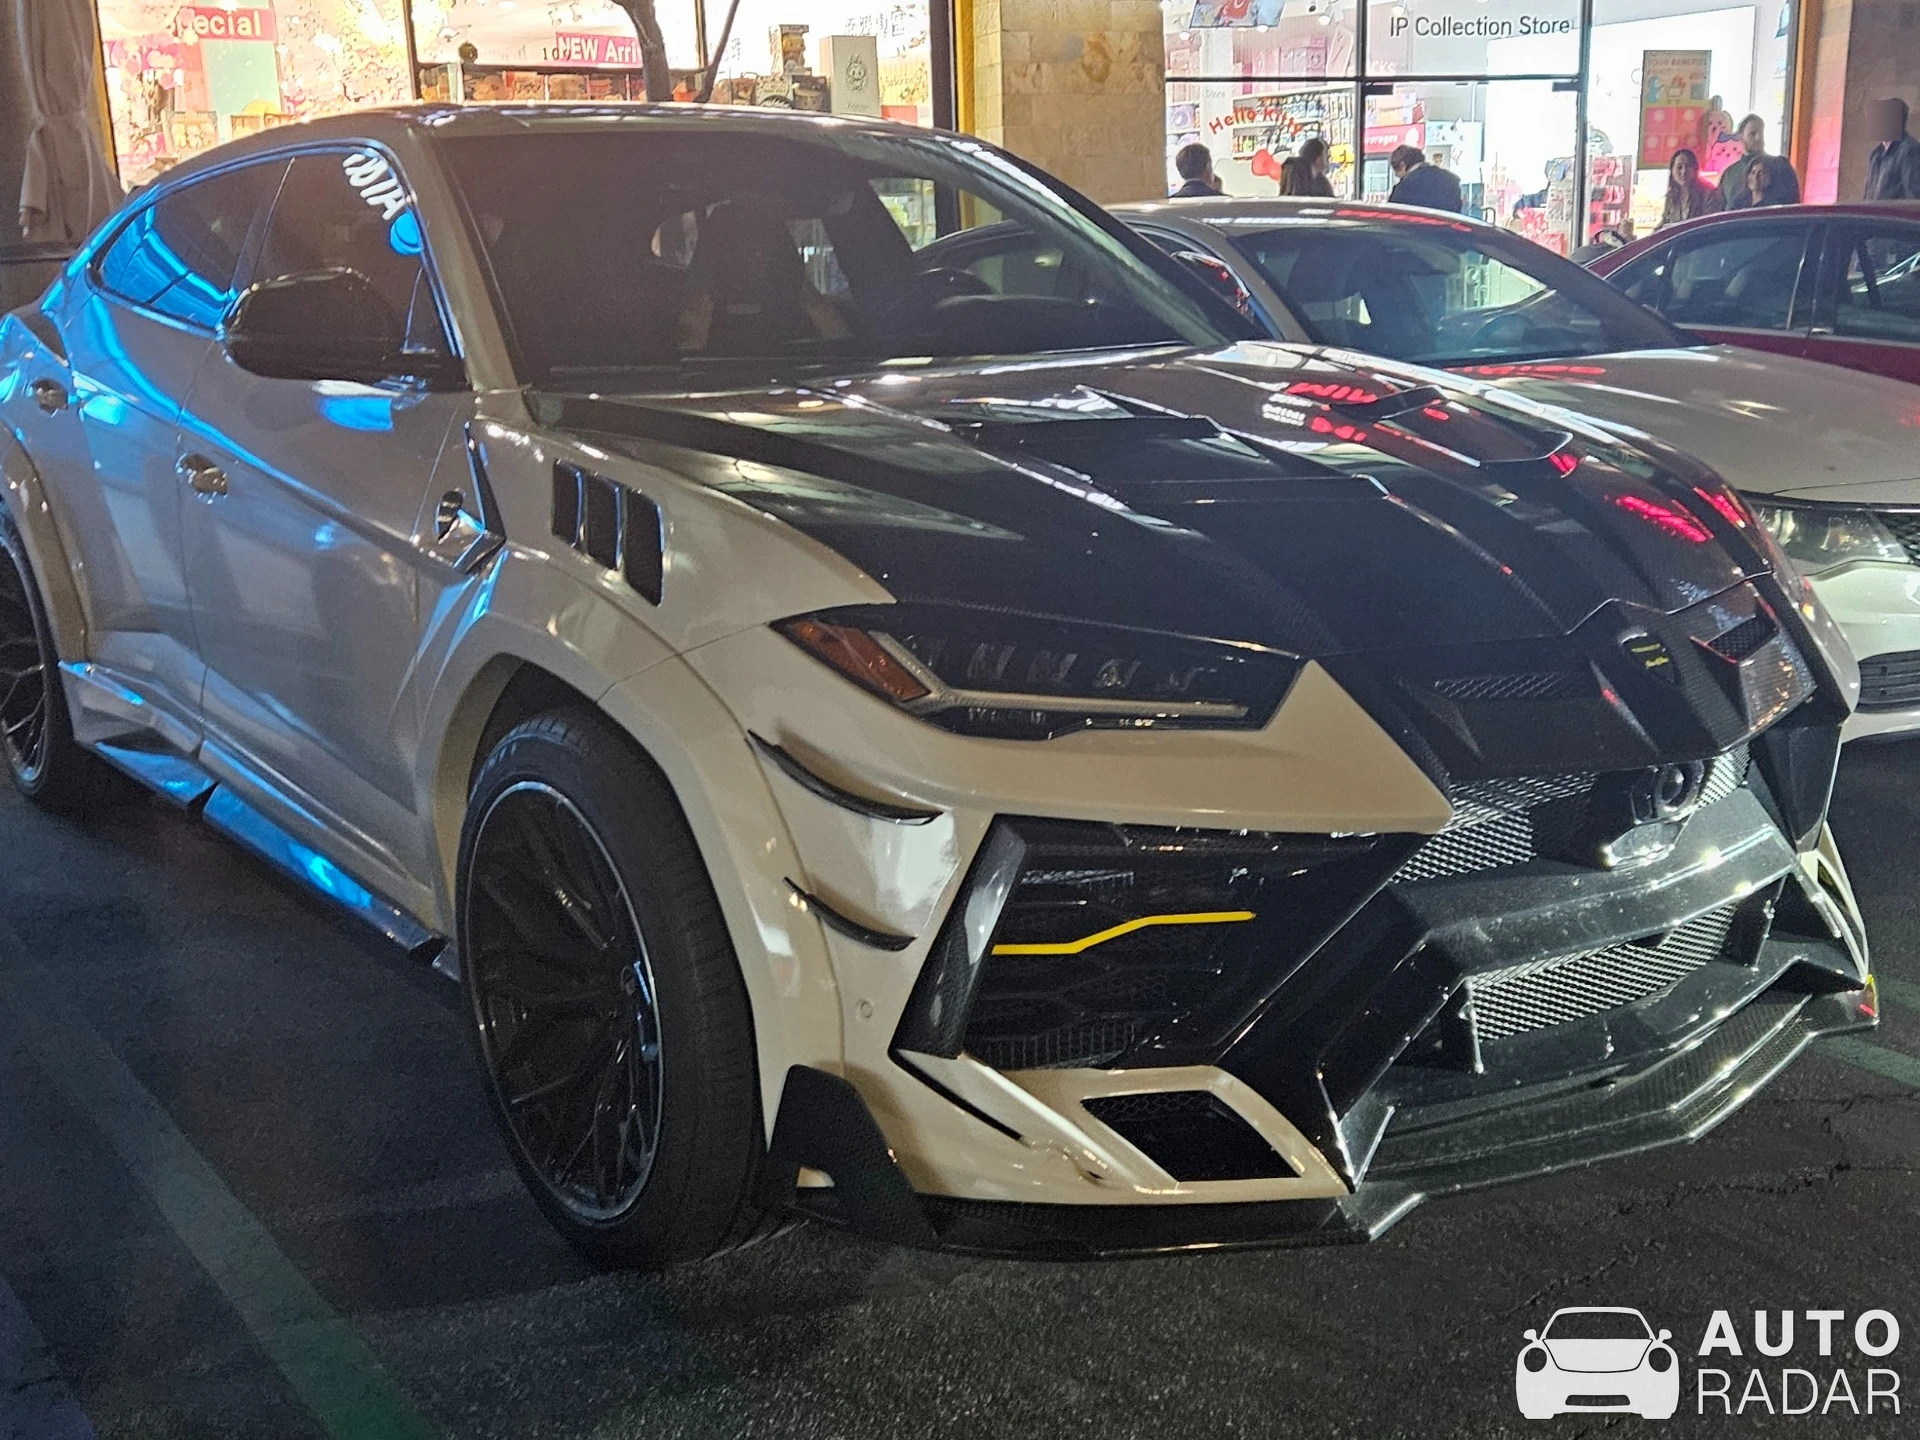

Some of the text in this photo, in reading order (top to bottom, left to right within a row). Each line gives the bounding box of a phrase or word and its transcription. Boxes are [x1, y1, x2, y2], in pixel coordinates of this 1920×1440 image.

[1390, 15, 1570, 37] IP Collection Store
[557, 35, 599, 62] NEW
[1209, 106, 1257, 135] Hello
